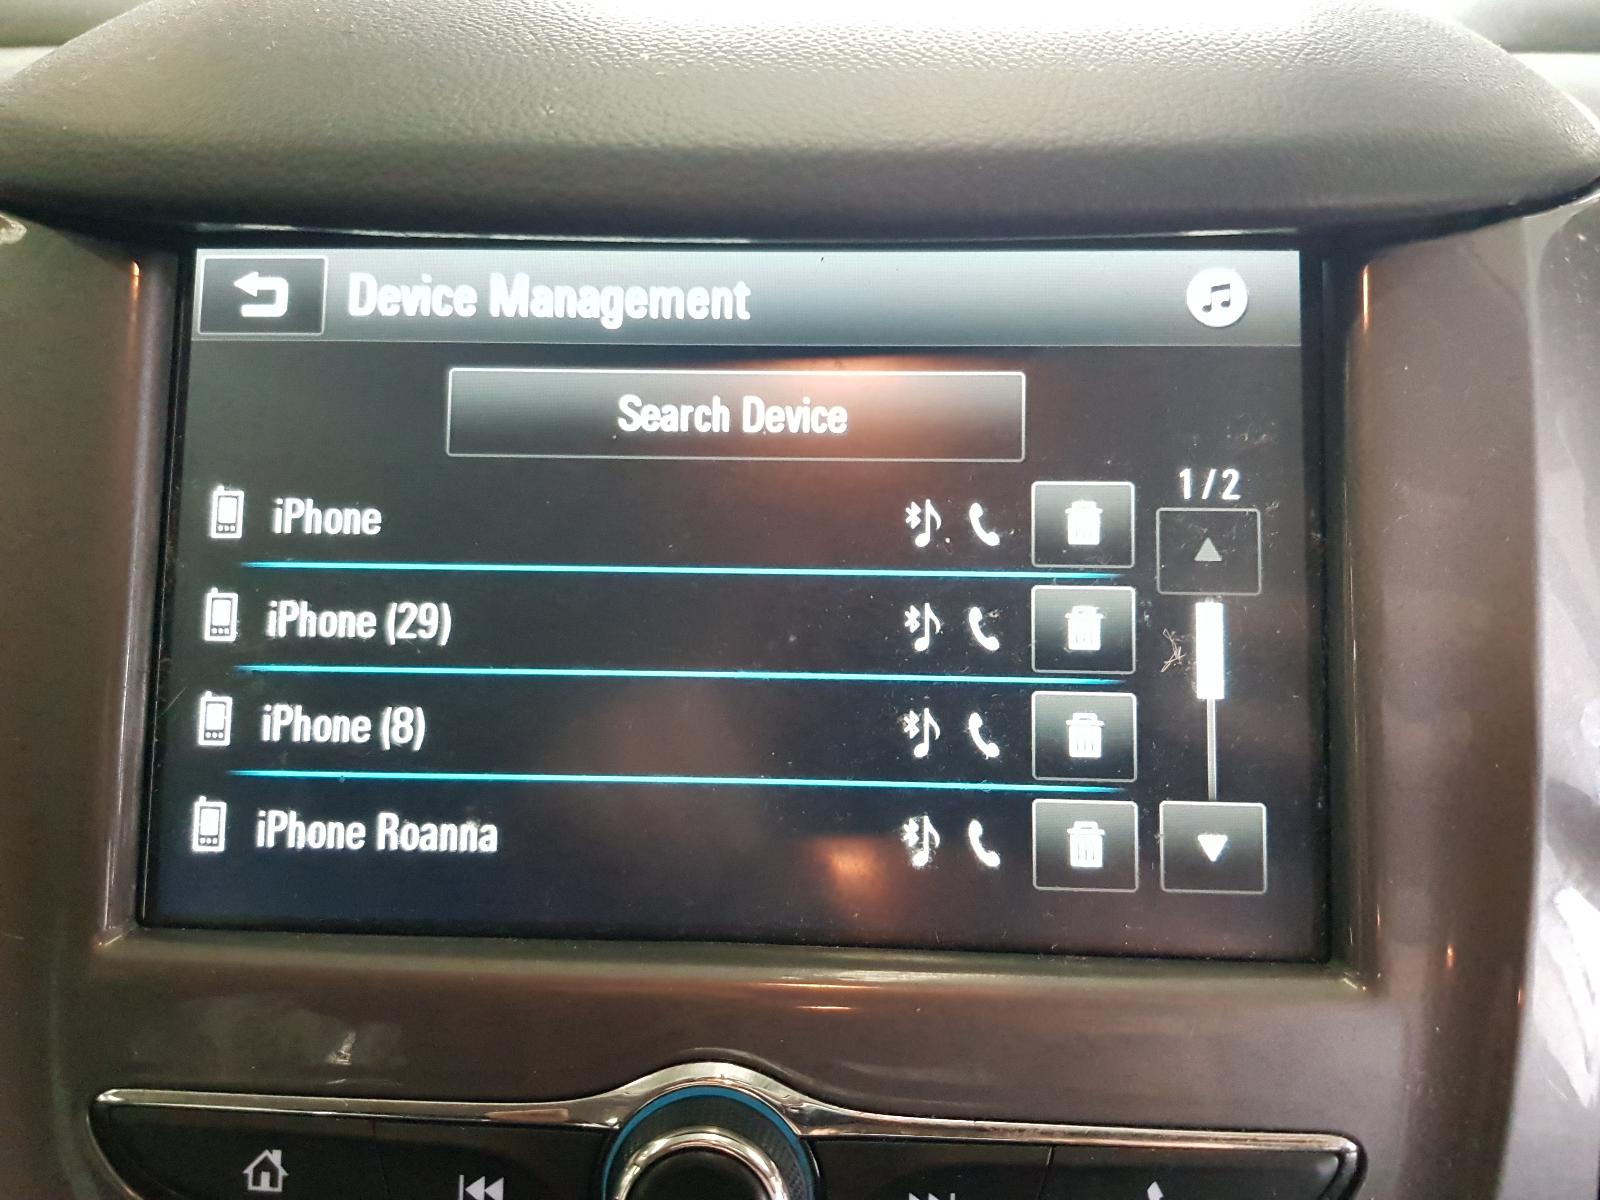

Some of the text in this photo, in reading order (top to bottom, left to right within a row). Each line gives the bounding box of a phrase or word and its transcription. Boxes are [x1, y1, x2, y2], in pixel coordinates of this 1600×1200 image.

[348, 272, 752, 330] Device Management
[617, 394, 849, 435] Search Device
[272, 497, 383, 536] iPhone
[265, 600, 452, 647] iPhone (29)
[260, 704, 427, 752] iPhone (8)
[255, 809, 499, 854] iPhone Roanna
